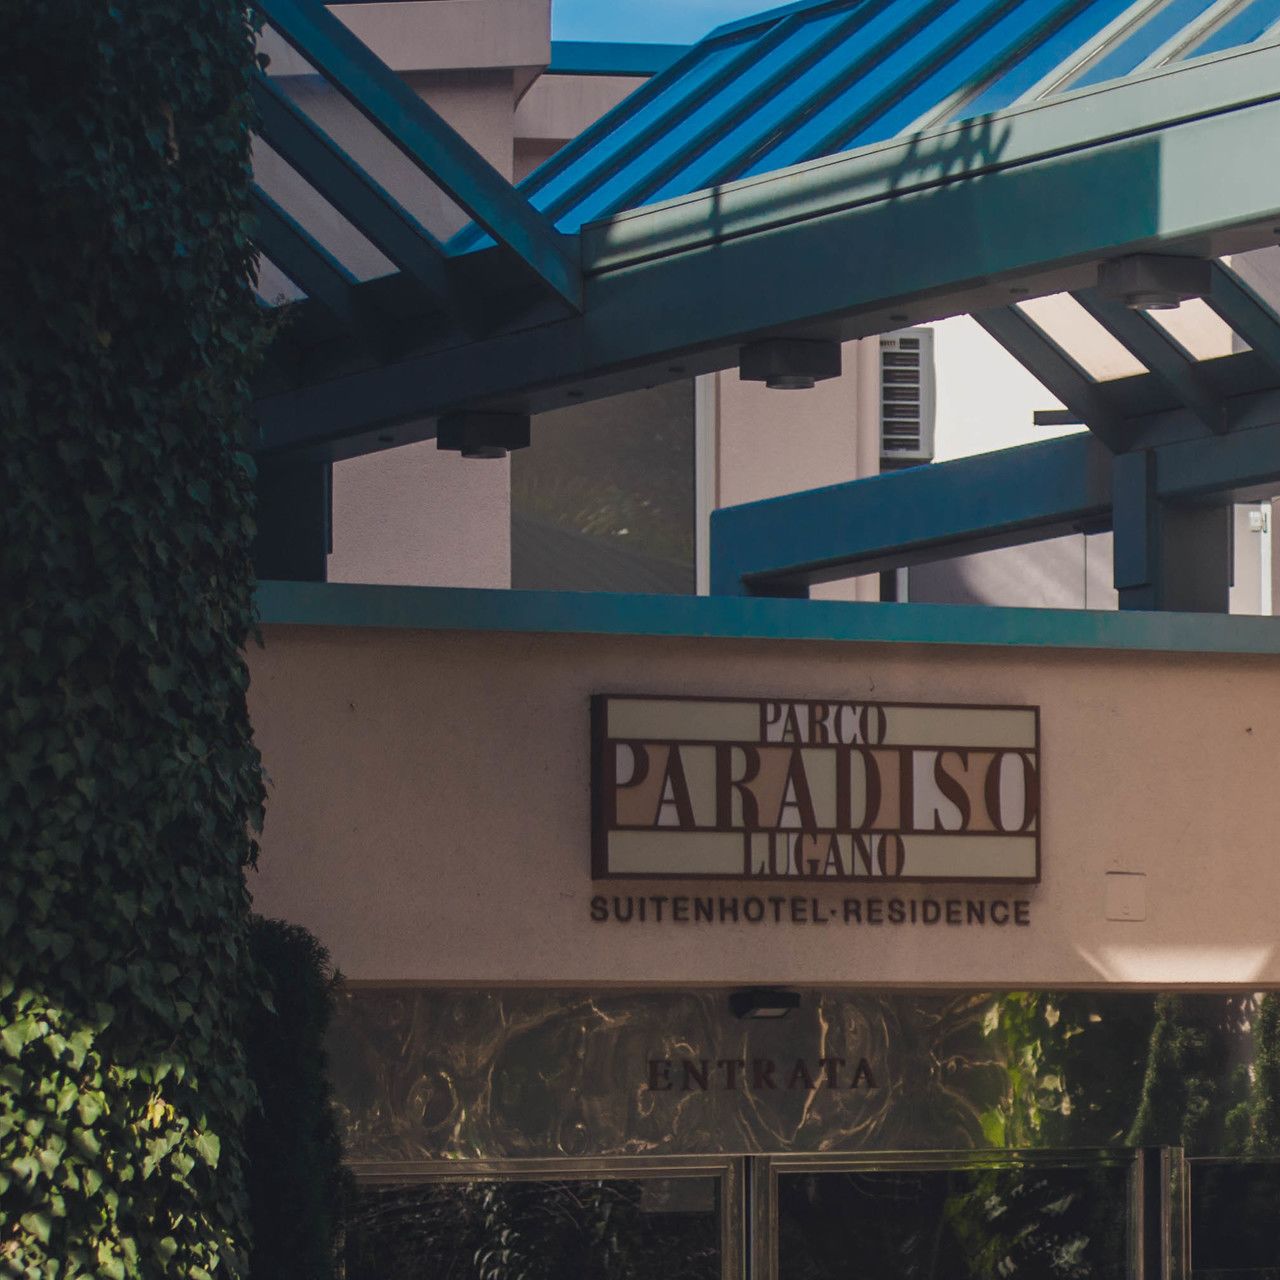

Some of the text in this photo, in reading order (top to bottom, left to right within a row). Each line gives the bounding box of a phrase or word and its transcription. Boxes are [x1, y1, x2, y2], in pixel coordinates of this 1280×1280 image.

[760, 702, 886, 746] PARCO
[604, 743, 1036, 832] PARADISO
[744, 833, 905, 876] LUGANO
[648, 1057, 876, 1091] ENTRATA
